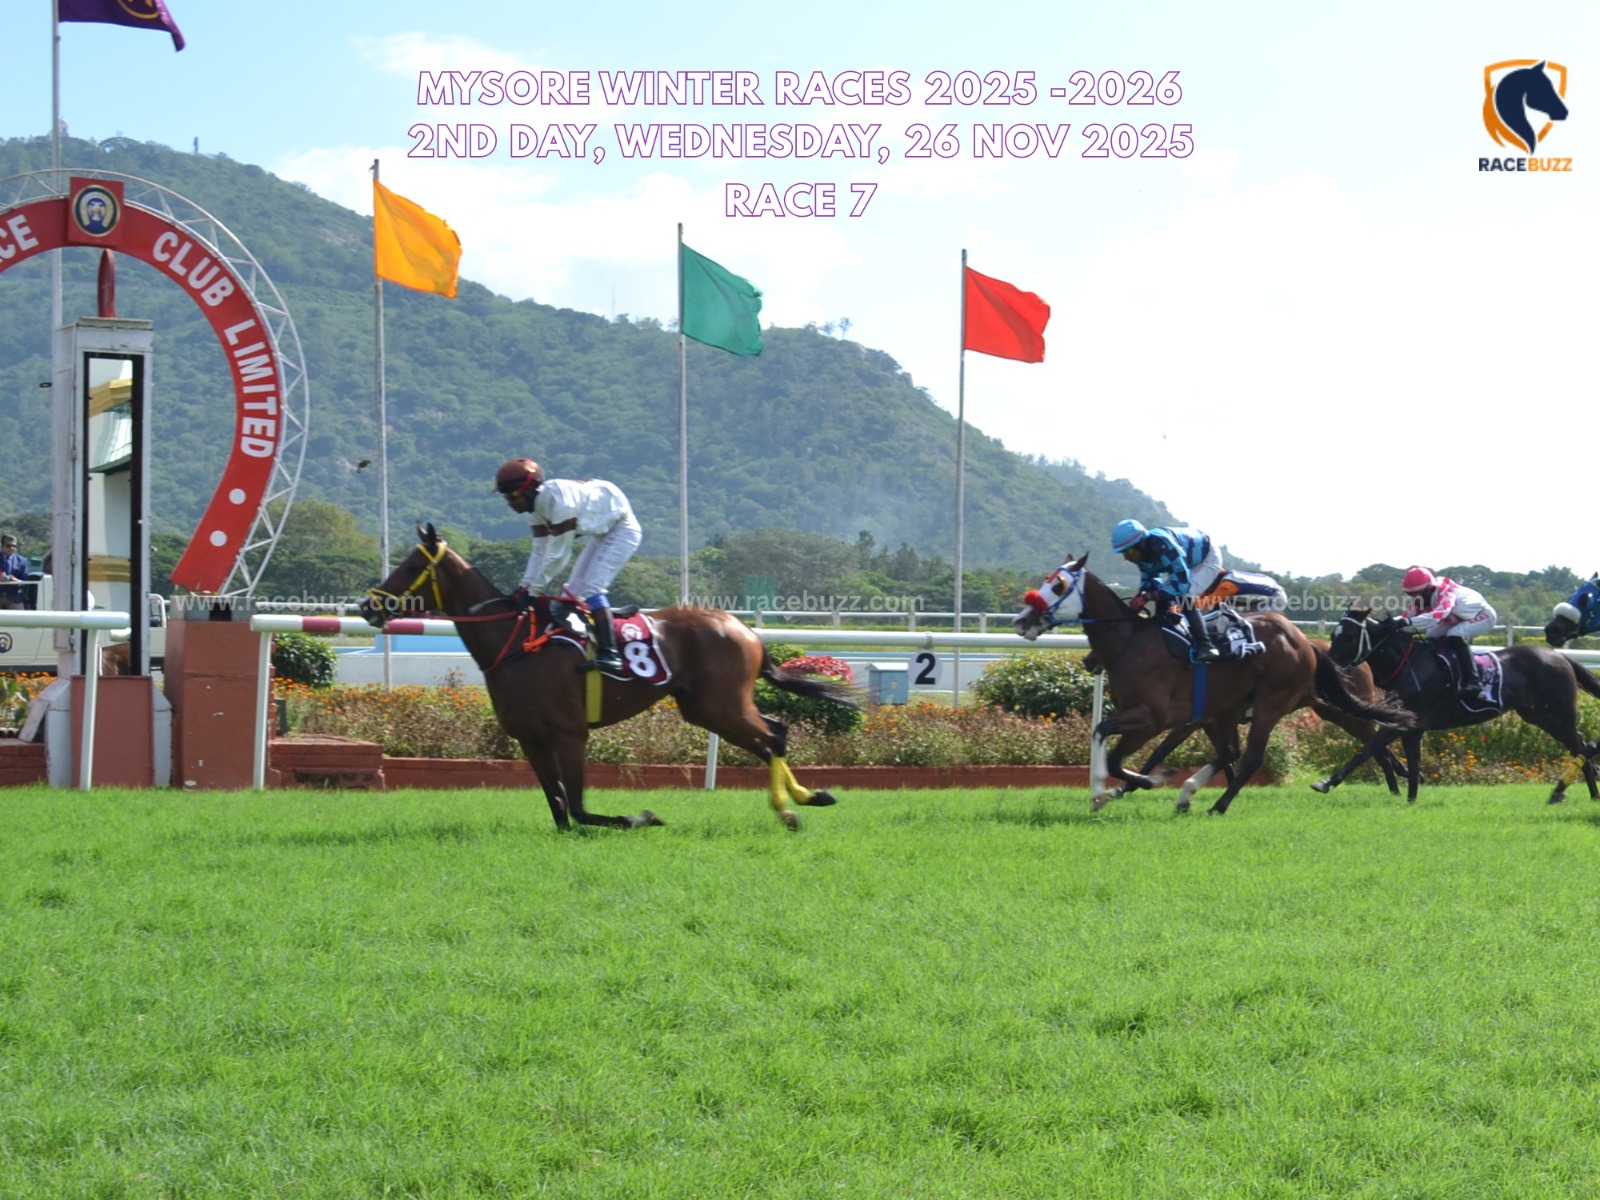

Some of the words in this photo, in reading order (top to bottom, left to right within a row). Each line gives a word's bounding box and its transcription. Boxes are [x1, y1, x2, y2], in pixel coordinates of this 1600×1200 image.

[0, 214, 39, 261] CE
[152, 231, 235, 306] CLUB
[224, 318, 277, 459] LIMITED
[624, 641, 657, 677] 8
[915, 653, 936, 685] 2
